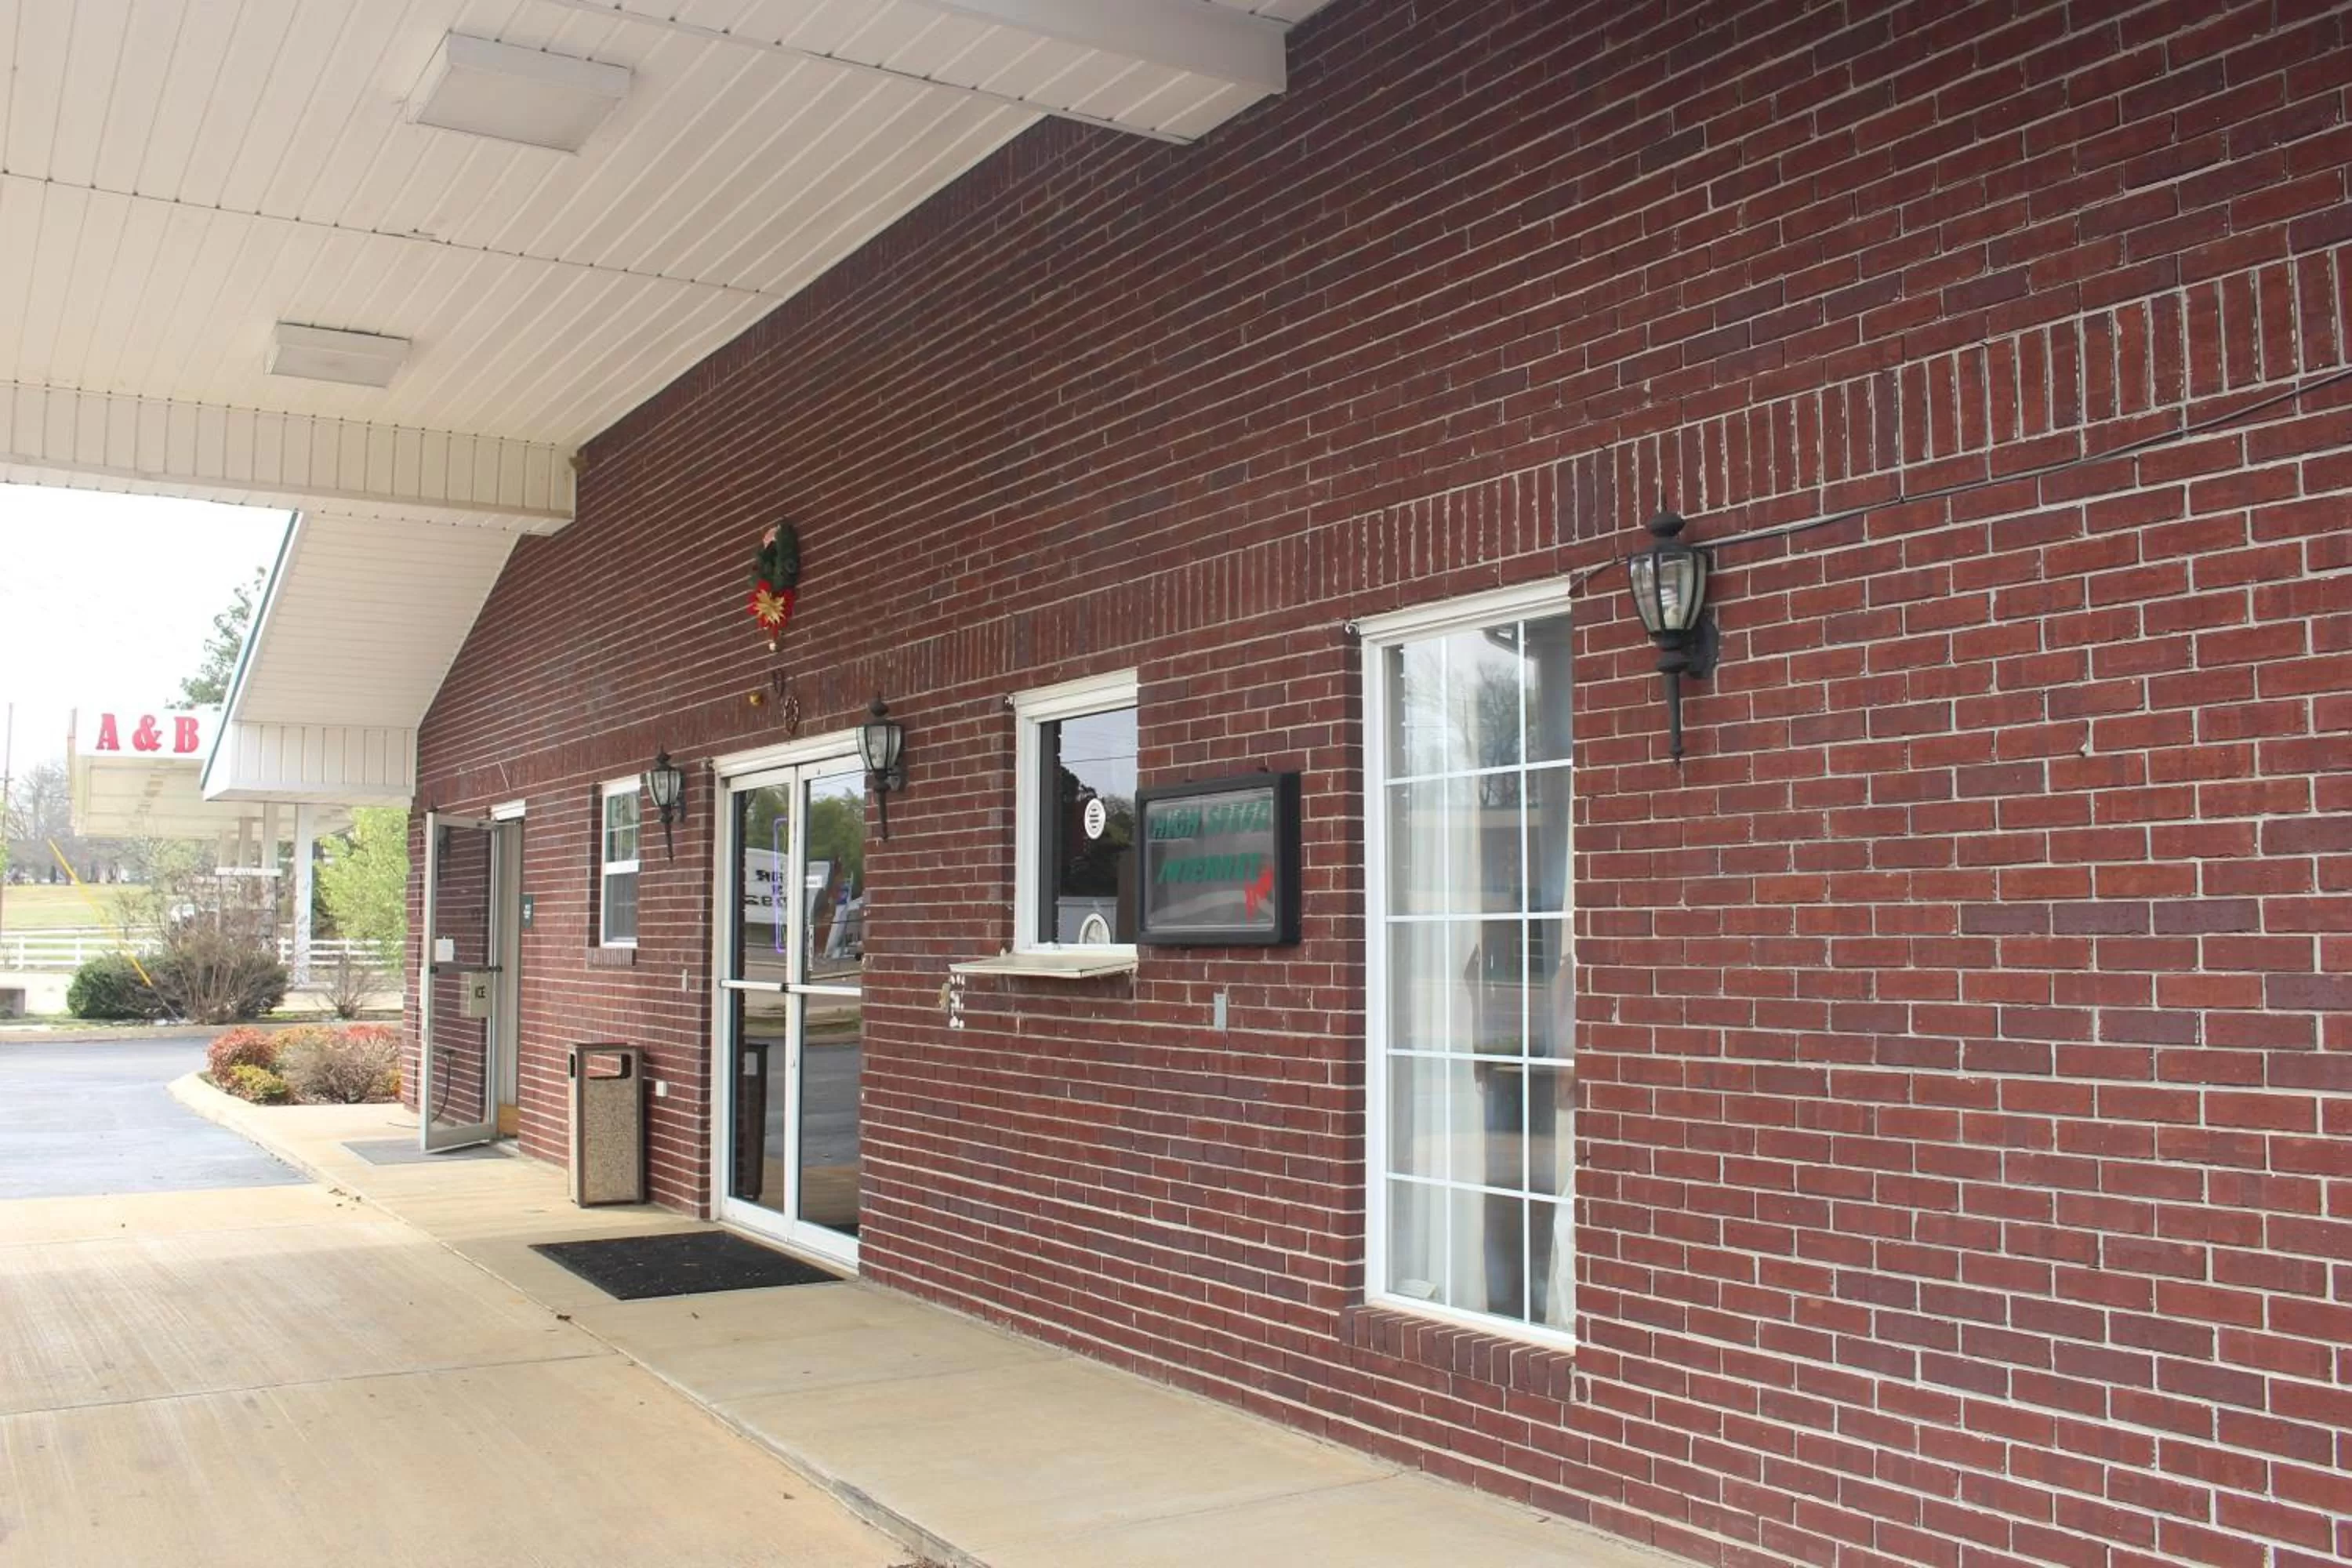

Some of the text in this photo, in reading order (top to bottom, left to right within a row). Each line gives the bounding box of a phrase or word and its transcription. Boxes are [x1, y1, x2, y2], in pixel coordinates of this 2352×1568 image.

[96, 713, 200, 753] A & B
